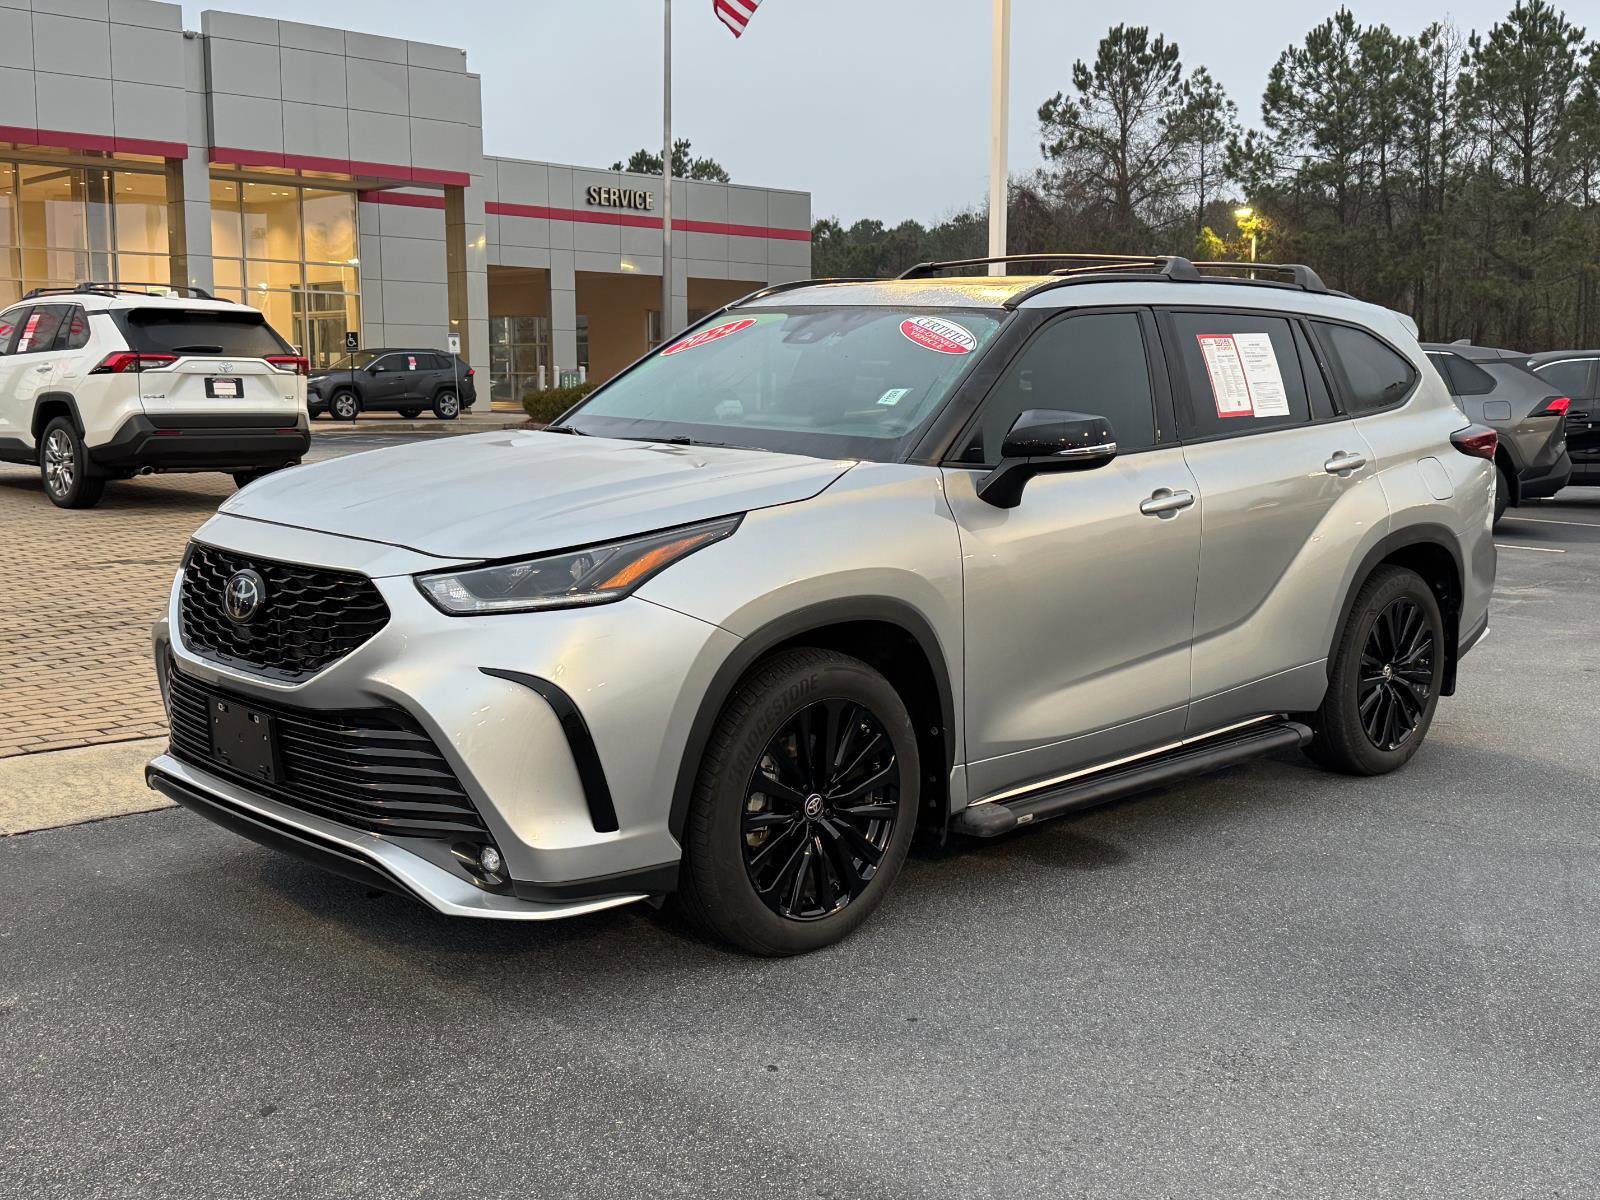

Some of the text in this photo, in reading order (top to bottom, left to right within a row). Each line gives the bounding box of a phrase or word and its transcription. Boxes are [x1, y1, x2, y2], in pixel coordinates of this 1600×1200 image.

[588, 186, 654, 210] SERVICE
[670, 320, 744, 354] 2024
[908, 324, 957, 348] PRE-OWNED
[911, 331, 943, 349] VEHICLE
[916, 318, 972, 345] CERTIFIED
